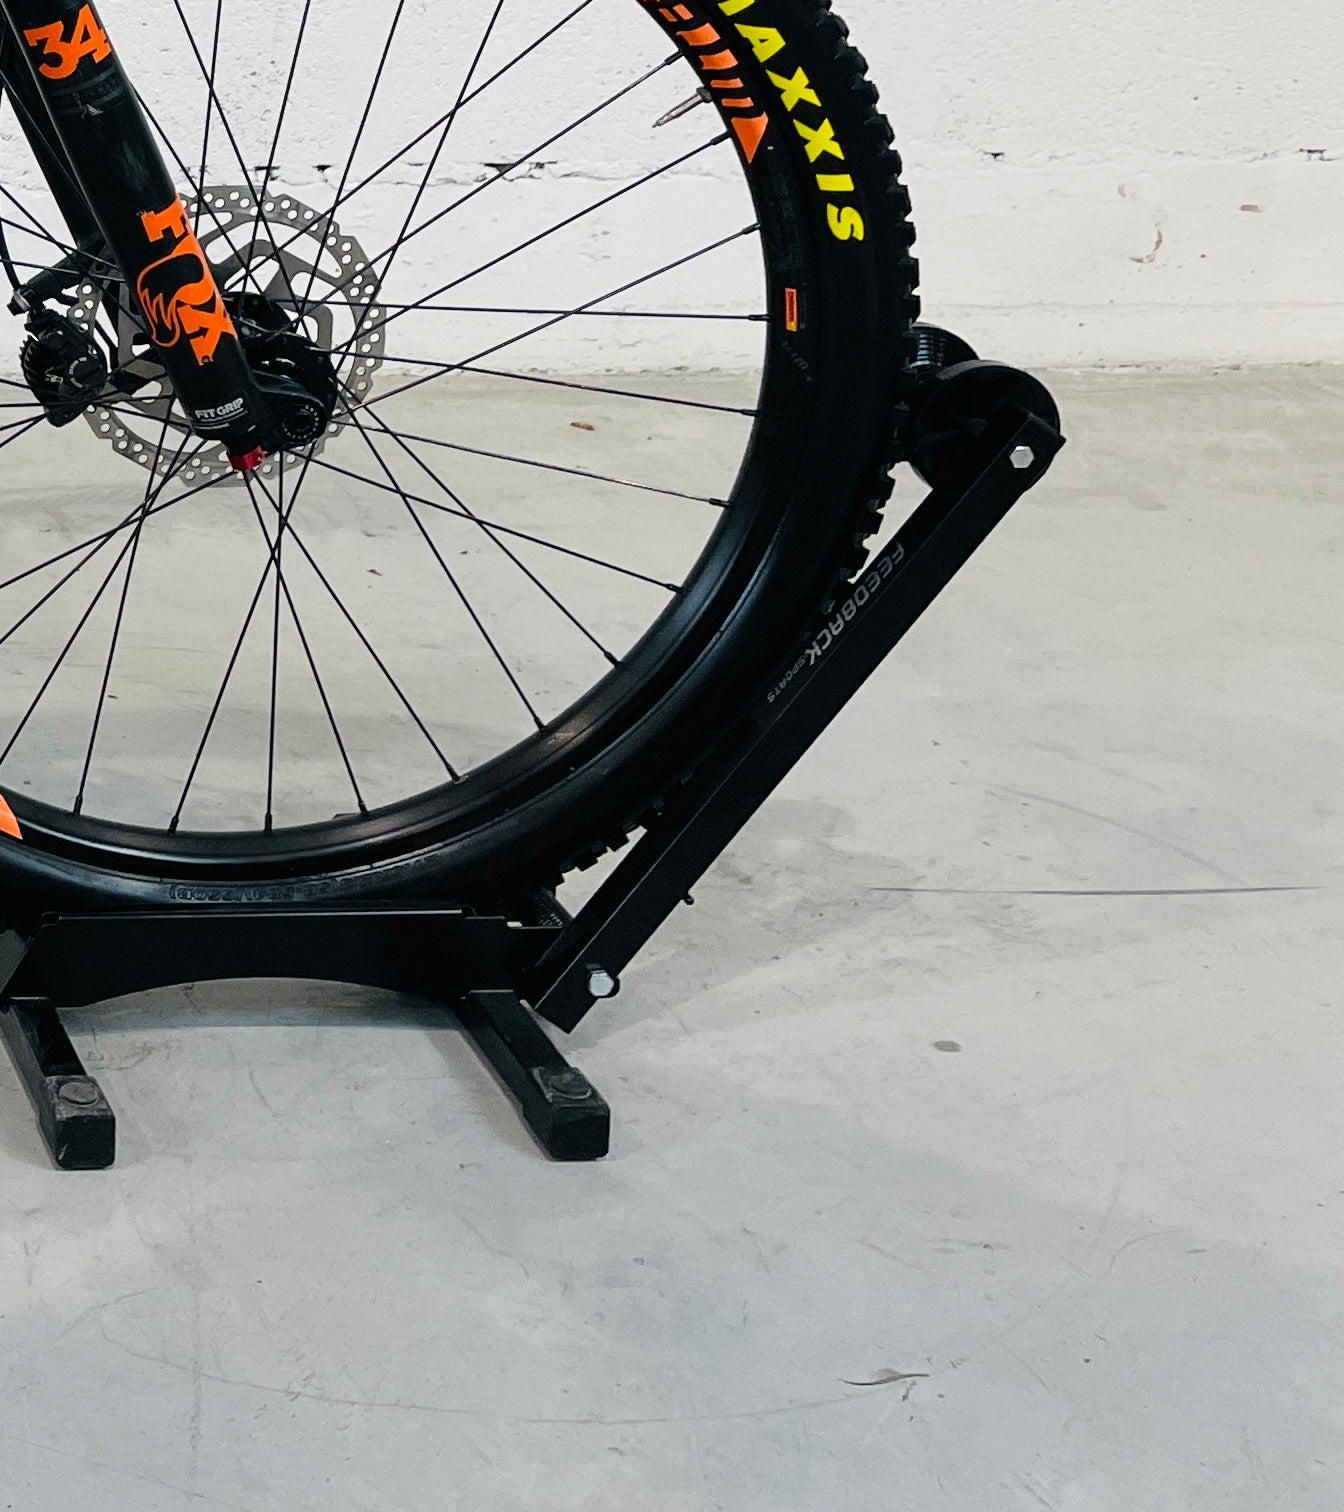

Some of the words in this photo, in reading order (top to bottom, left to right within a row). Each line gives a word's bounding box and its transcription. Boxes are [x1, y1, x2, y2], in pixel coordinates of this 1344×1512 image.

[23, 3, 112, 79] 34
[137, 193, 239, 366] FOX
[216, 397, 244, 416] GRIP
[804, 541, 905, 666] FEEDBACK
